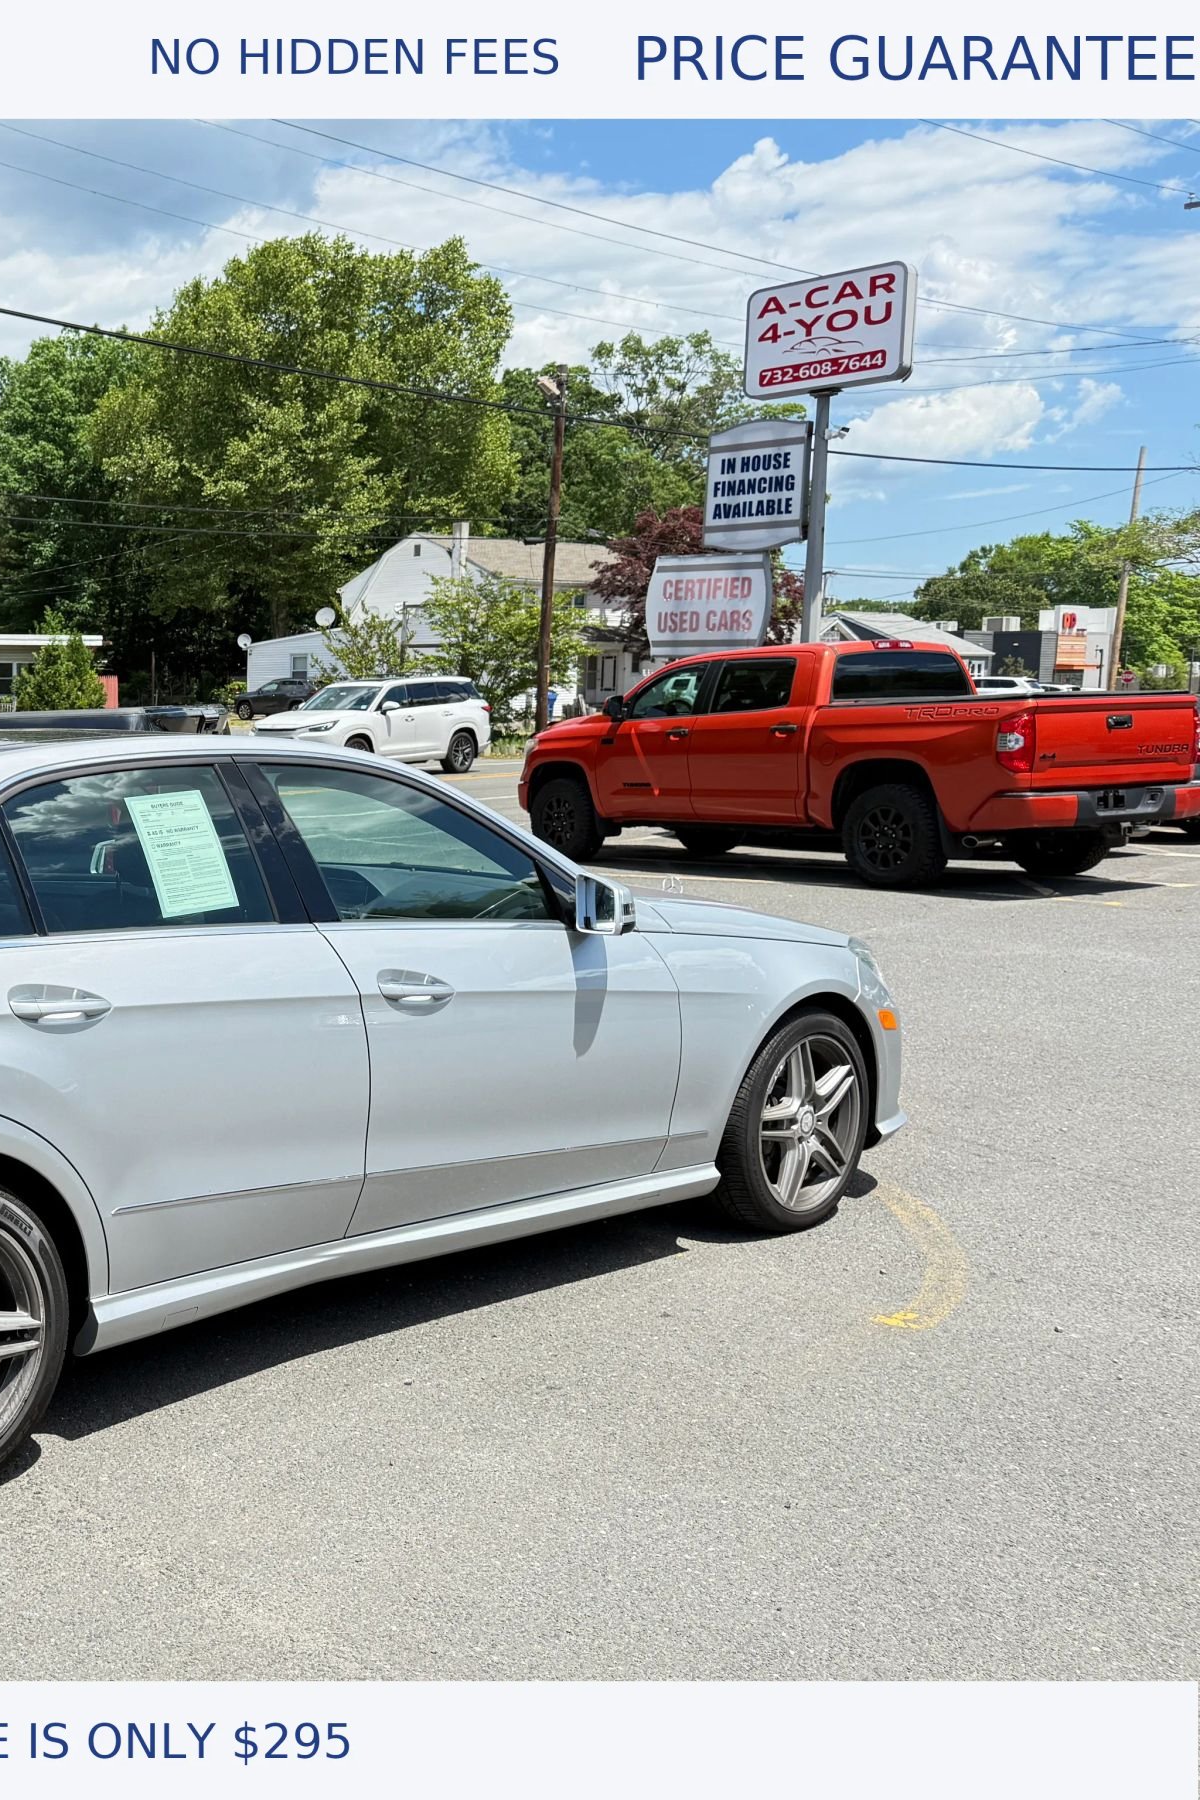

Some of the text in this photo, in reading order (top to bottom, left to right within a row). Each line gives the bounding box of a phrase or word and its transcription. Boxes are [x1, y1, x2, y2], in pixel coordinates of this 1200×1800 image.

[757, 273, 896, 319] A-CAR
[758, 301, 893, 344] 4-YOU
[761, 353, 884, 385] 732-608-7644
[720, 452, 791, 475] IN HOUSE
[713, 474, 796, 498] FINANCING
[712, 497, 793, 520] AVAILABLE
[663, 576, 753, 602] CERTIFIED
[657, 609, 753, 633] USED CARS
[904, 706, 1000, 720] TRD PRO
[1137, 743, 1189, 754] TUNDRA
